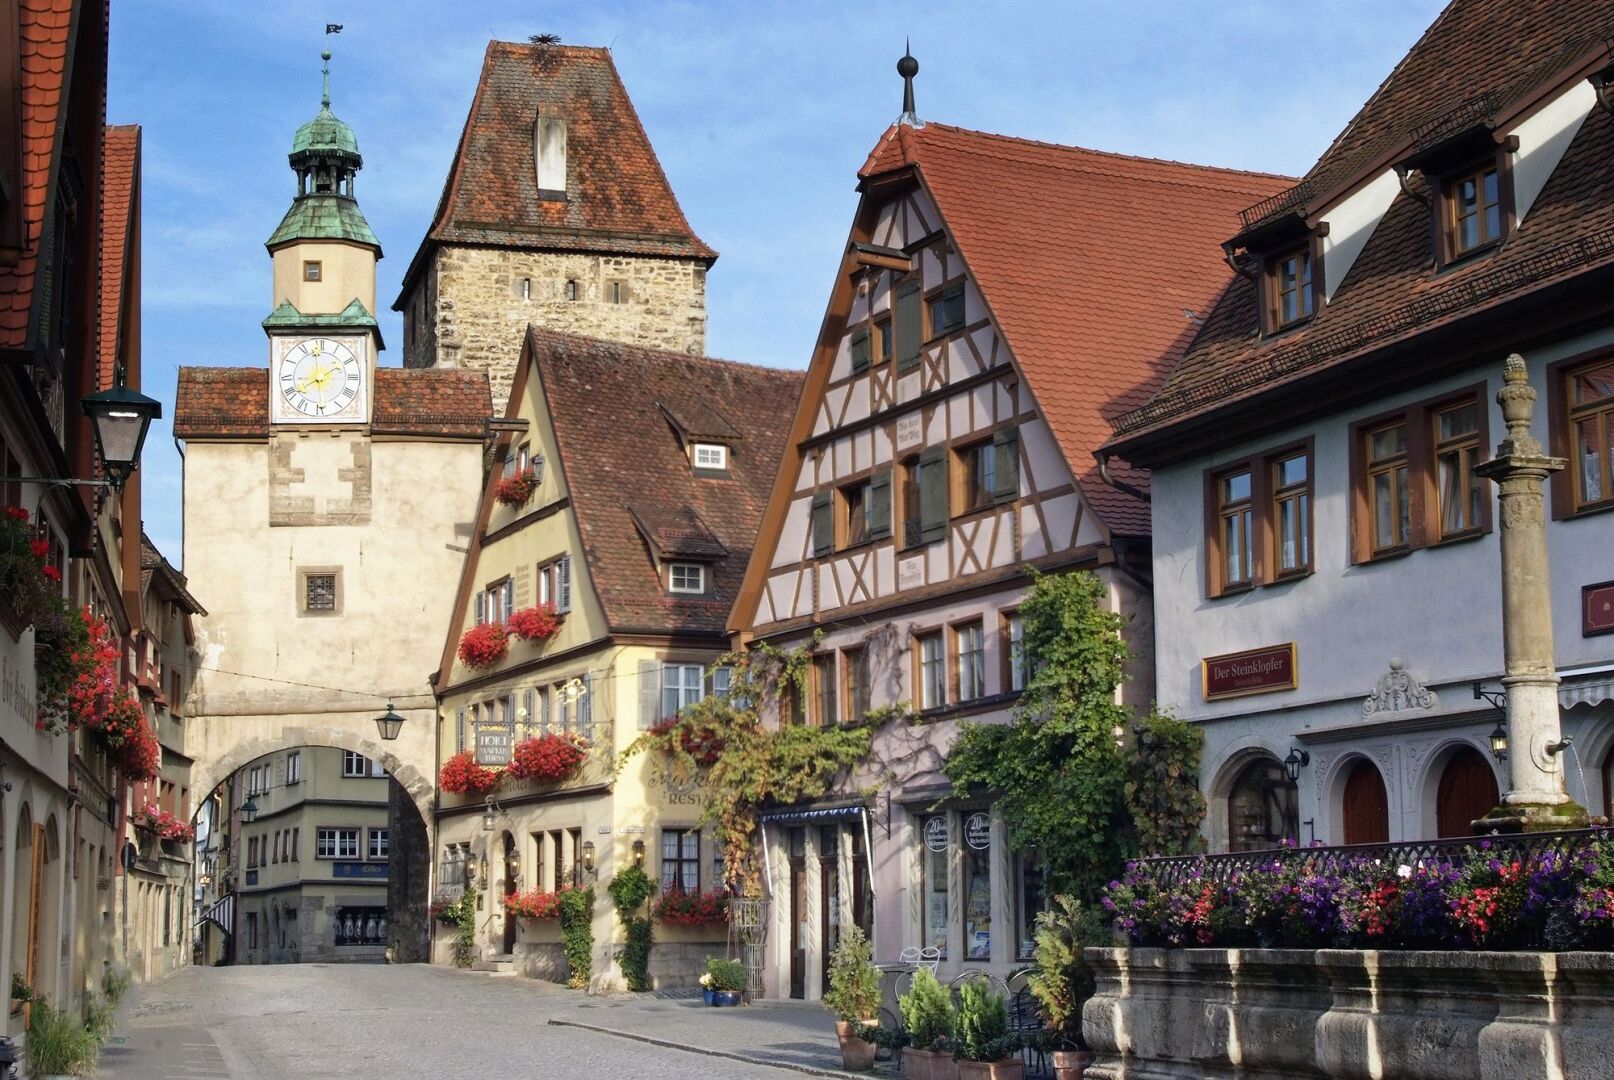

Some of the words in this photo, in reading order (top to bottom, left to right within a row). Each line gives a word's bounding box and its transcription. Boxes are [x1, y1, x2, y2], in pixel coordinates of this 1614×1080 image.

[1214, 666, 1230, 680] Der
[1231, 658, 1283, 677] Steinklopfer
[929, 820, 940, 833] 20
[971, 816, 982, 830] 20
